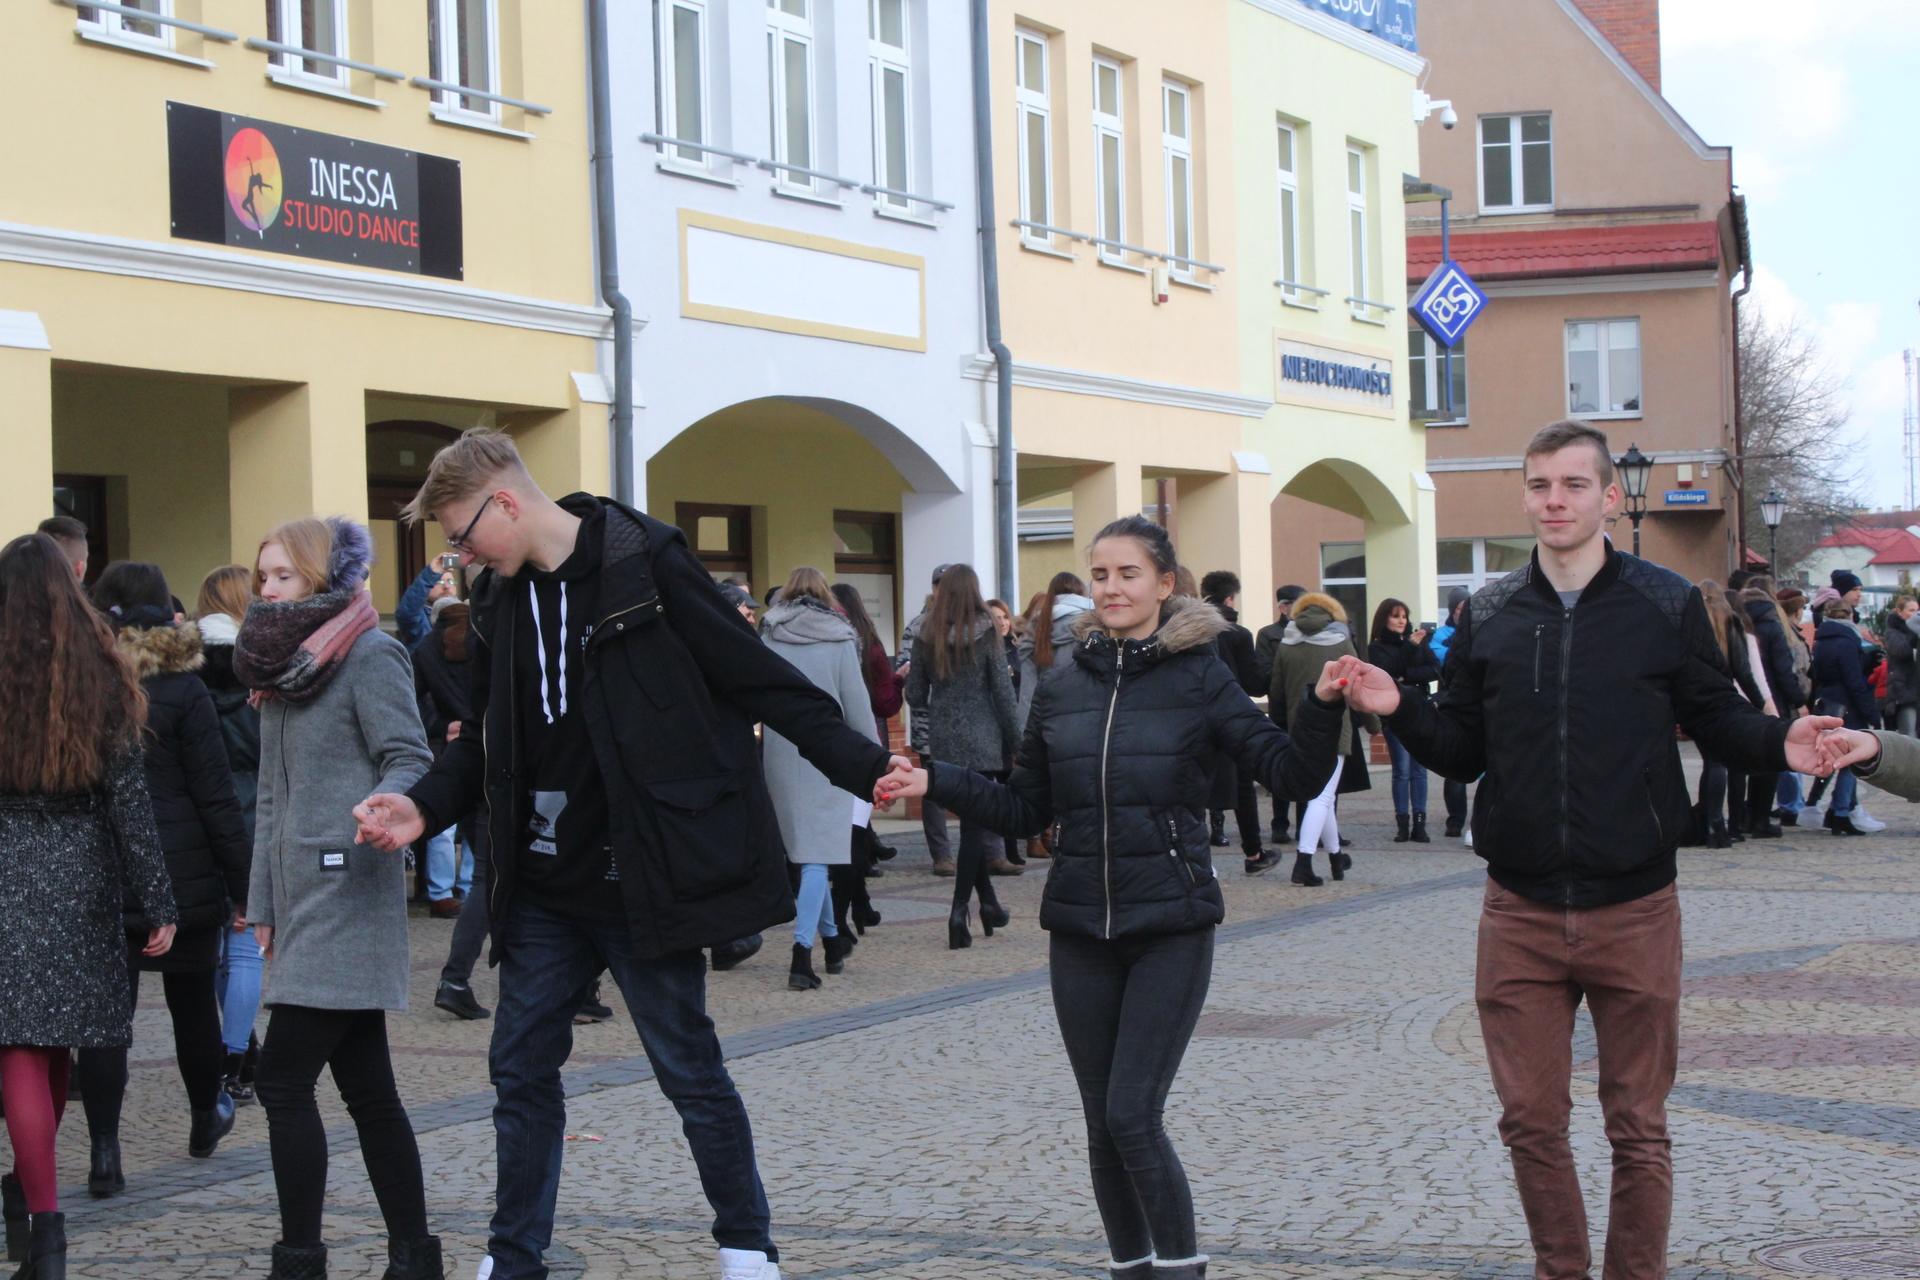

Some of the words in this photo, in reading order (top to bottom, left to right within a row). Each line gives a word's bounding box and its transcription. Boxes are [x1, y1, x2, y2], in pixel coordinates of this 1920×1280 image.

[309, 157, 398, 211] INESSA
[283, 199, 354, 237] STUDIO
[358, 212, 419, 248] DANCE
[1281, 354, 1391, 396] NIERUCHOMOŚCI
[1668, 493, 1706, 503] Kilińskiego
